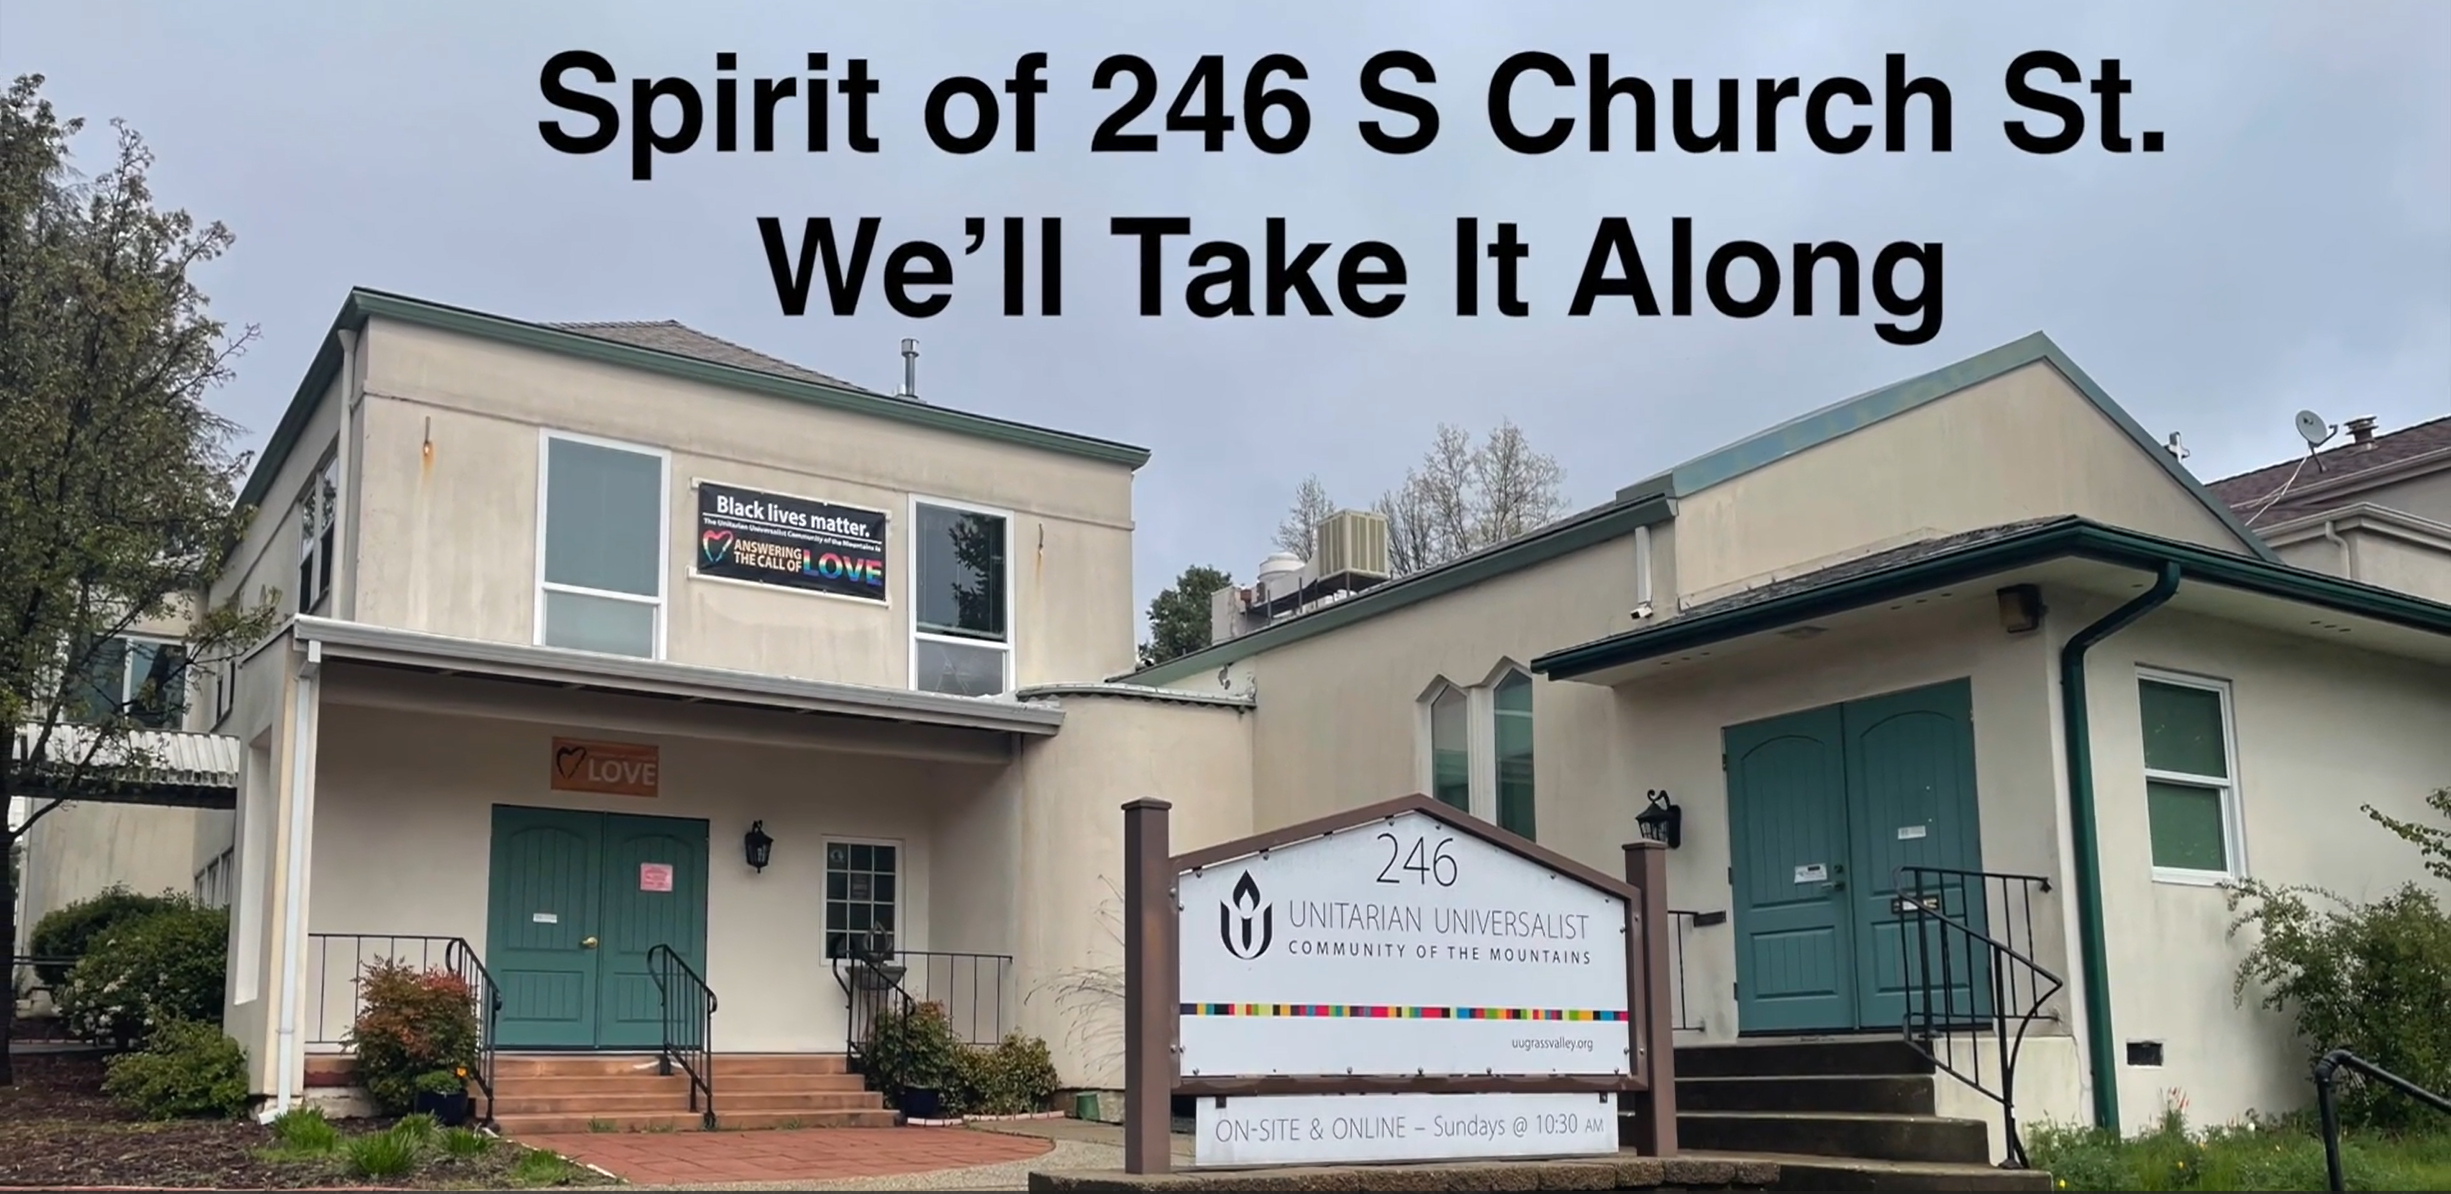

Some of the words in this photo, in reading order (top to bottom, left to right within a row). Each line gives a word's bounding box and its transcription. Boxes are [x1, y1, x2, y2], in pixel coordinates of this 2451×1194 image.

[717, 495, 765, 519] Black
[768, 503, 806, 527] lives
[811, 513, 870, 538] matter.
[703, 517, 717, 526] The
[717, 519, 749, 531] Unitarian
[749, 524, 787, 538] Universalist
[787, 531, 824, 545] Community
[824, 536, 832, 544] of
[832, 538, 842, 547] the
[842, 539, 875, 552] Mountains
[734, 539, 802, 560] ANSWERING
[734, 551, 756, 567] THE
[758, 555, 785, 571] CALL
[787, 560, 802, 573] OF
[803, 550, 882, 586] LOVE
[588, 758, 656, 786] LOVE
[1375, 832, 1458, 887] 246
[1289, 900, 1422, 933] UNITARIAN
[1435, 908, 1589, 940] UNIVERSALIST
[1288, 940, 1406, 959] COMMUNITY
[1416, 946, 1438, 960] OF
[1447, 946, 1480, 961] THE
[1490, 948, 1591, 965] MOUNTAINS
[1512, 1037, 1593, 1053] uugrassvalley.org
[1215, 1117, 1301, 1143] ON-SITE
[1309, 1118, 1324, 1141] &
[1332, 1116, 1406, 1140] ONLINE
[1434, 1113, 1506, 1142] Sundays
[1512, 1117, 1528, 1138] @
[1535, 1113, 1578, 1135] 10:30
[1585, 1118, 1605, 1134] AM
